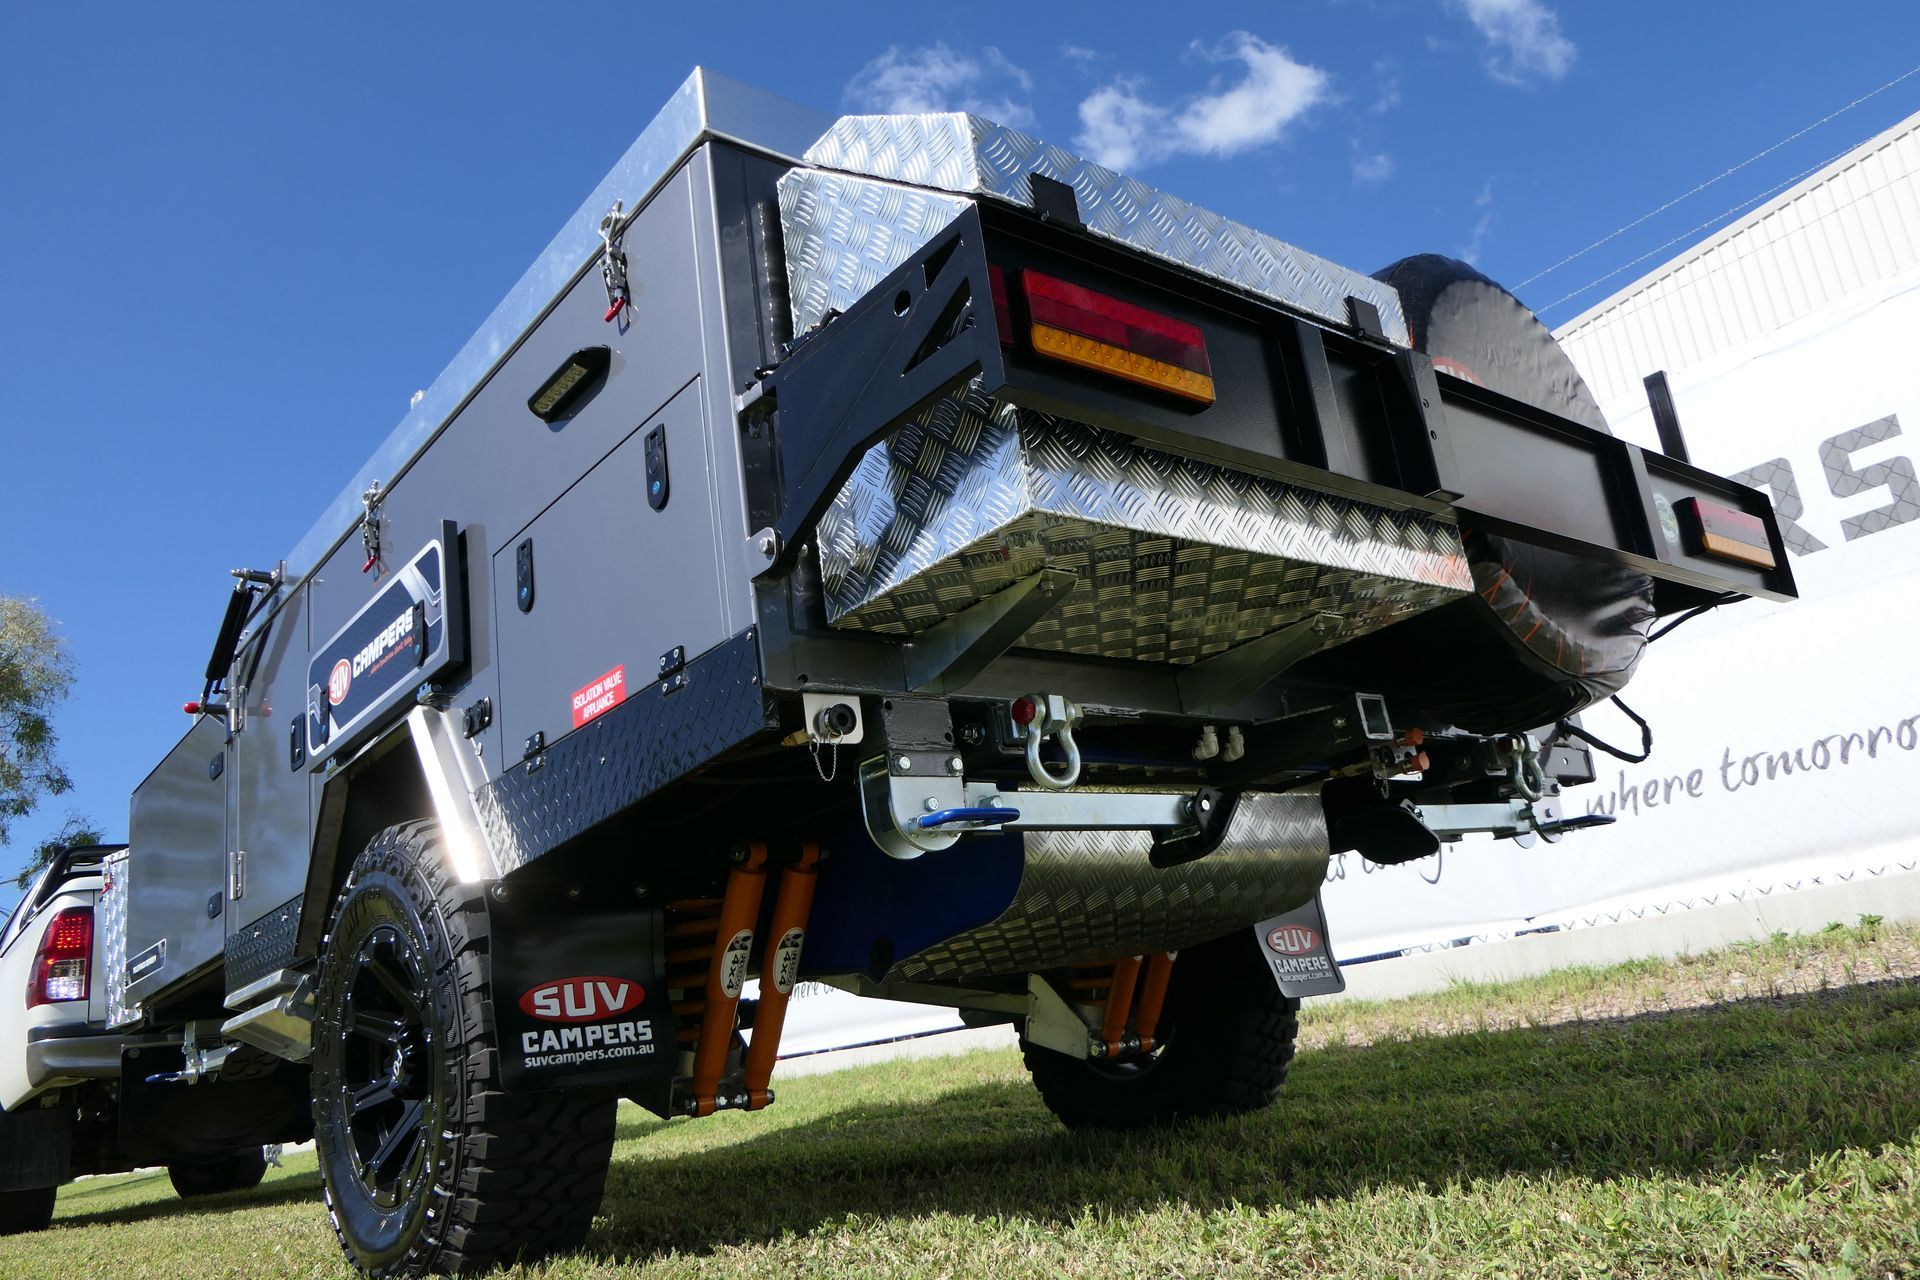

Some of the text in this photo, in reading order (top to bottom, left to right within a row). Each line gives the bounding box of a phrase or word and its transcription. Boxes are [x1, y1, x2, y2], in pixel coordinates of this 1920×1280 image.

[353, 606, 414, 679] CAMPERS
[330, 665, 349, 699] SUV
[573, 670, 622, 710] ISOLATION VALVE
[583, 690, 615, 720] APPLIANCE
[1586, 769, 1704, 817] where
[1272, 928, 1312, 952] SUV
[1274, 956, 1329, 973] CAMPERS
[533, 981, 630, 1017] SUV
[522, 1020, 653, 1054] CAMPERS
[524, 1043, 655, 1068] suvcampers.com.au
